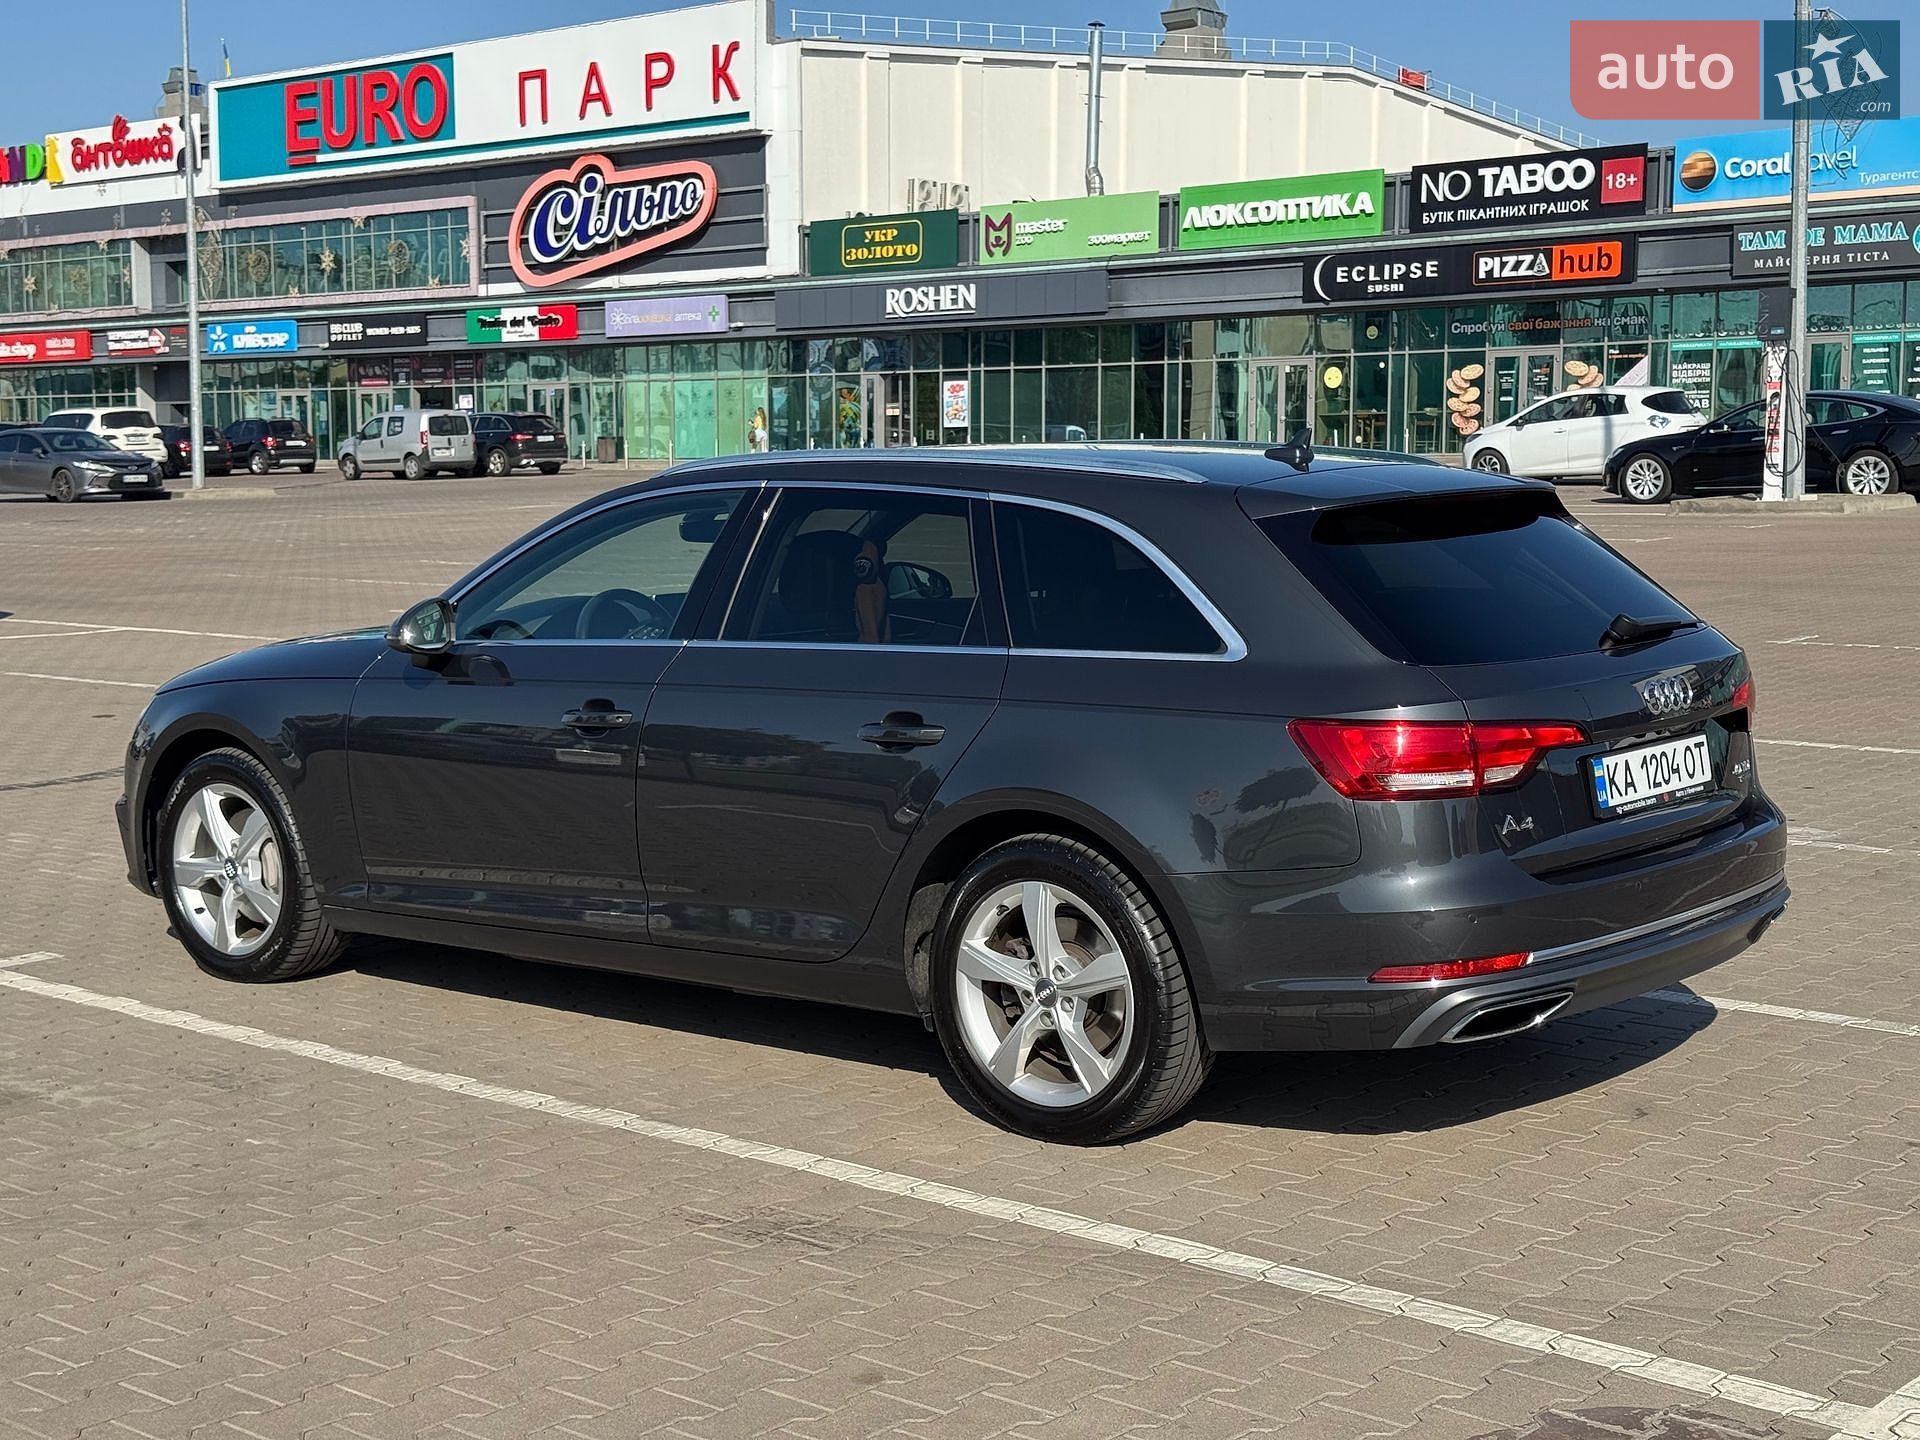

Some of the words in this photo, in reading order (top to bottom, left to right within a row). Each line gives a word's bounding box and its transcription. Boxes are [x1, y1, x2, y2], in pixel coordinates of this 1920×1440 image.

[518, 41, 740, 127] ПАРК
[284, 61, 448, 154] EURO
[1724, 152, 1789, 178] Coral
[1421, 170, 1471, 203] NO
[1478, 158, 1595, 197] TABOO
[1605, 173, 1638, 190] 18+
[527, 172, 705, 264] Сільпо
[1182, 191, 1375, 230] ЛЮКСОПТИКА
[1422, 210, 1454, 224] БУТІК
[1457, 204, 1527, 221] ПІКАНТНИХ
[1529, 199, 1589, 216] ІГРАШОК
[864, 228, 898, 243] УКР
[1015, 218, 1068, 234] master
[1015, 235, 1033, 246] zoo
[1087, 231, 1152, 246] зоомаркет
[846, 243, 918, 261] ЗОЛОТО
[1478, 252, 1550, 279] PIZZA
[1558, 246, 1613, 274] hub
[1753, 251, 1840, 269] МАЙСЕРНЯ
[1847, 250, 1890, 263] ТІСТА
[1336, 260, 1439, 283] ECLIPSE
[1367, 283, 1404, 293] SUSHI
[885, 283, 976, 317] ROSHEN
[1451, 321, 1505, 335] Спробуй
[1508, 319, 1534, 331] свої
[1535, 317, 1592, 330] бажання
[1594, 315, 1610, 327] на
[1613, 313, 1647, 326] смак
[1606, 759, 1637, 800] KA
[1640, 748, 1682, 790] 1204
[1684, 741, 1705, 780] OT
[1597, 789, 1607, 802] UA
[1502, 814, 1535, 835] A4
